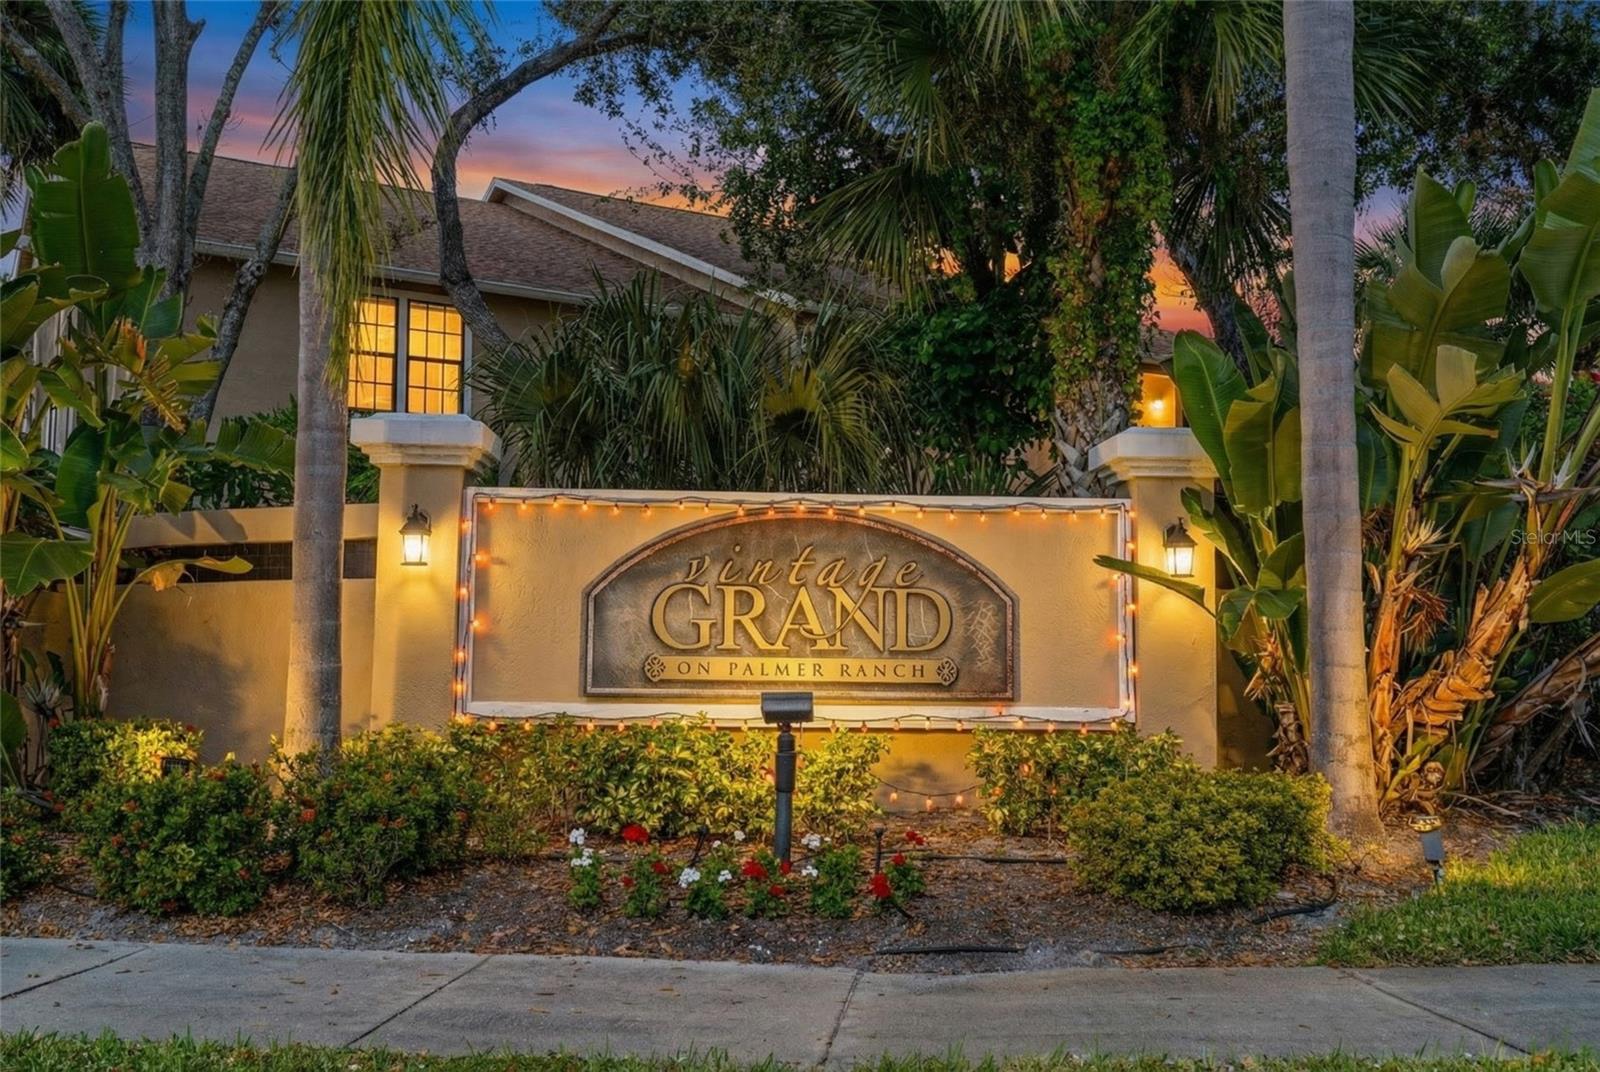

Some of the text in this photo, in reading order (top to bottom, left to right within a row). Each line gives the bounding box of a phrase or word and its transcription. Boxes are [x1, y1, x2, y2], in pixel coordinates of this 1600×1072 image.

[651, 583, 953, 652] GRAND
[678, 661, 926, 679] ON PALMER RANCH
